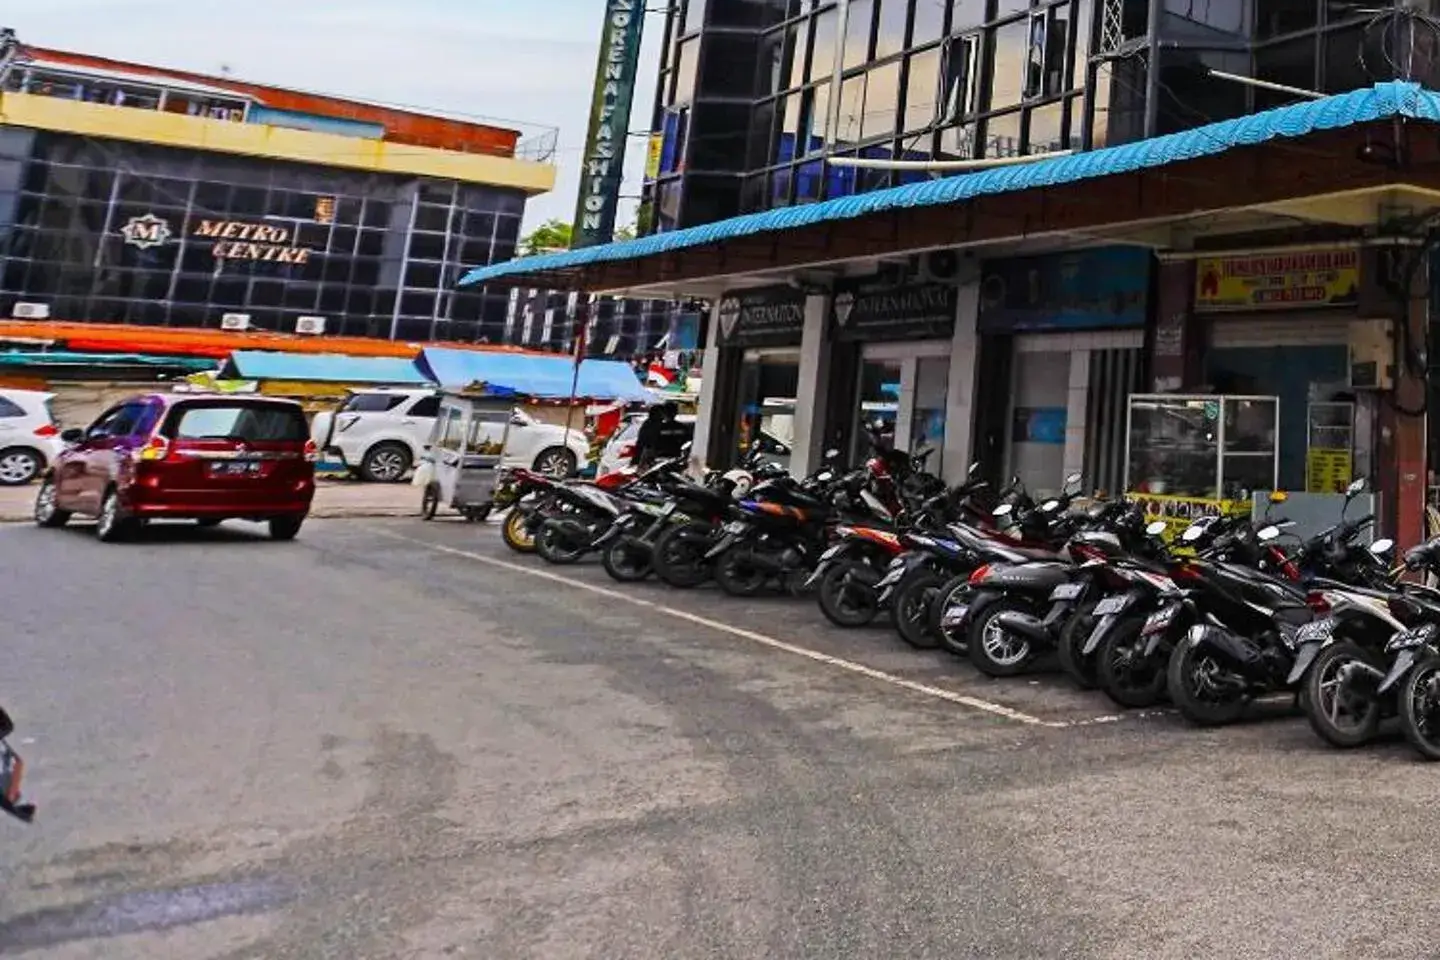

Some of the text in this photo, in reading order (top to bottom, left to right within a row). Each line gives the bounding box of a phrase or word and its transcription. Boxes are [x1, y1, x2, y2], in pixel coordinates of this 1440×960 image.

[583, 104, 617, 229] FASHION
[193, 219, 289, 243] METRO
[211, 241, 312, 264] CENTRE
[741, 301, 802, 326] INTERNATION
